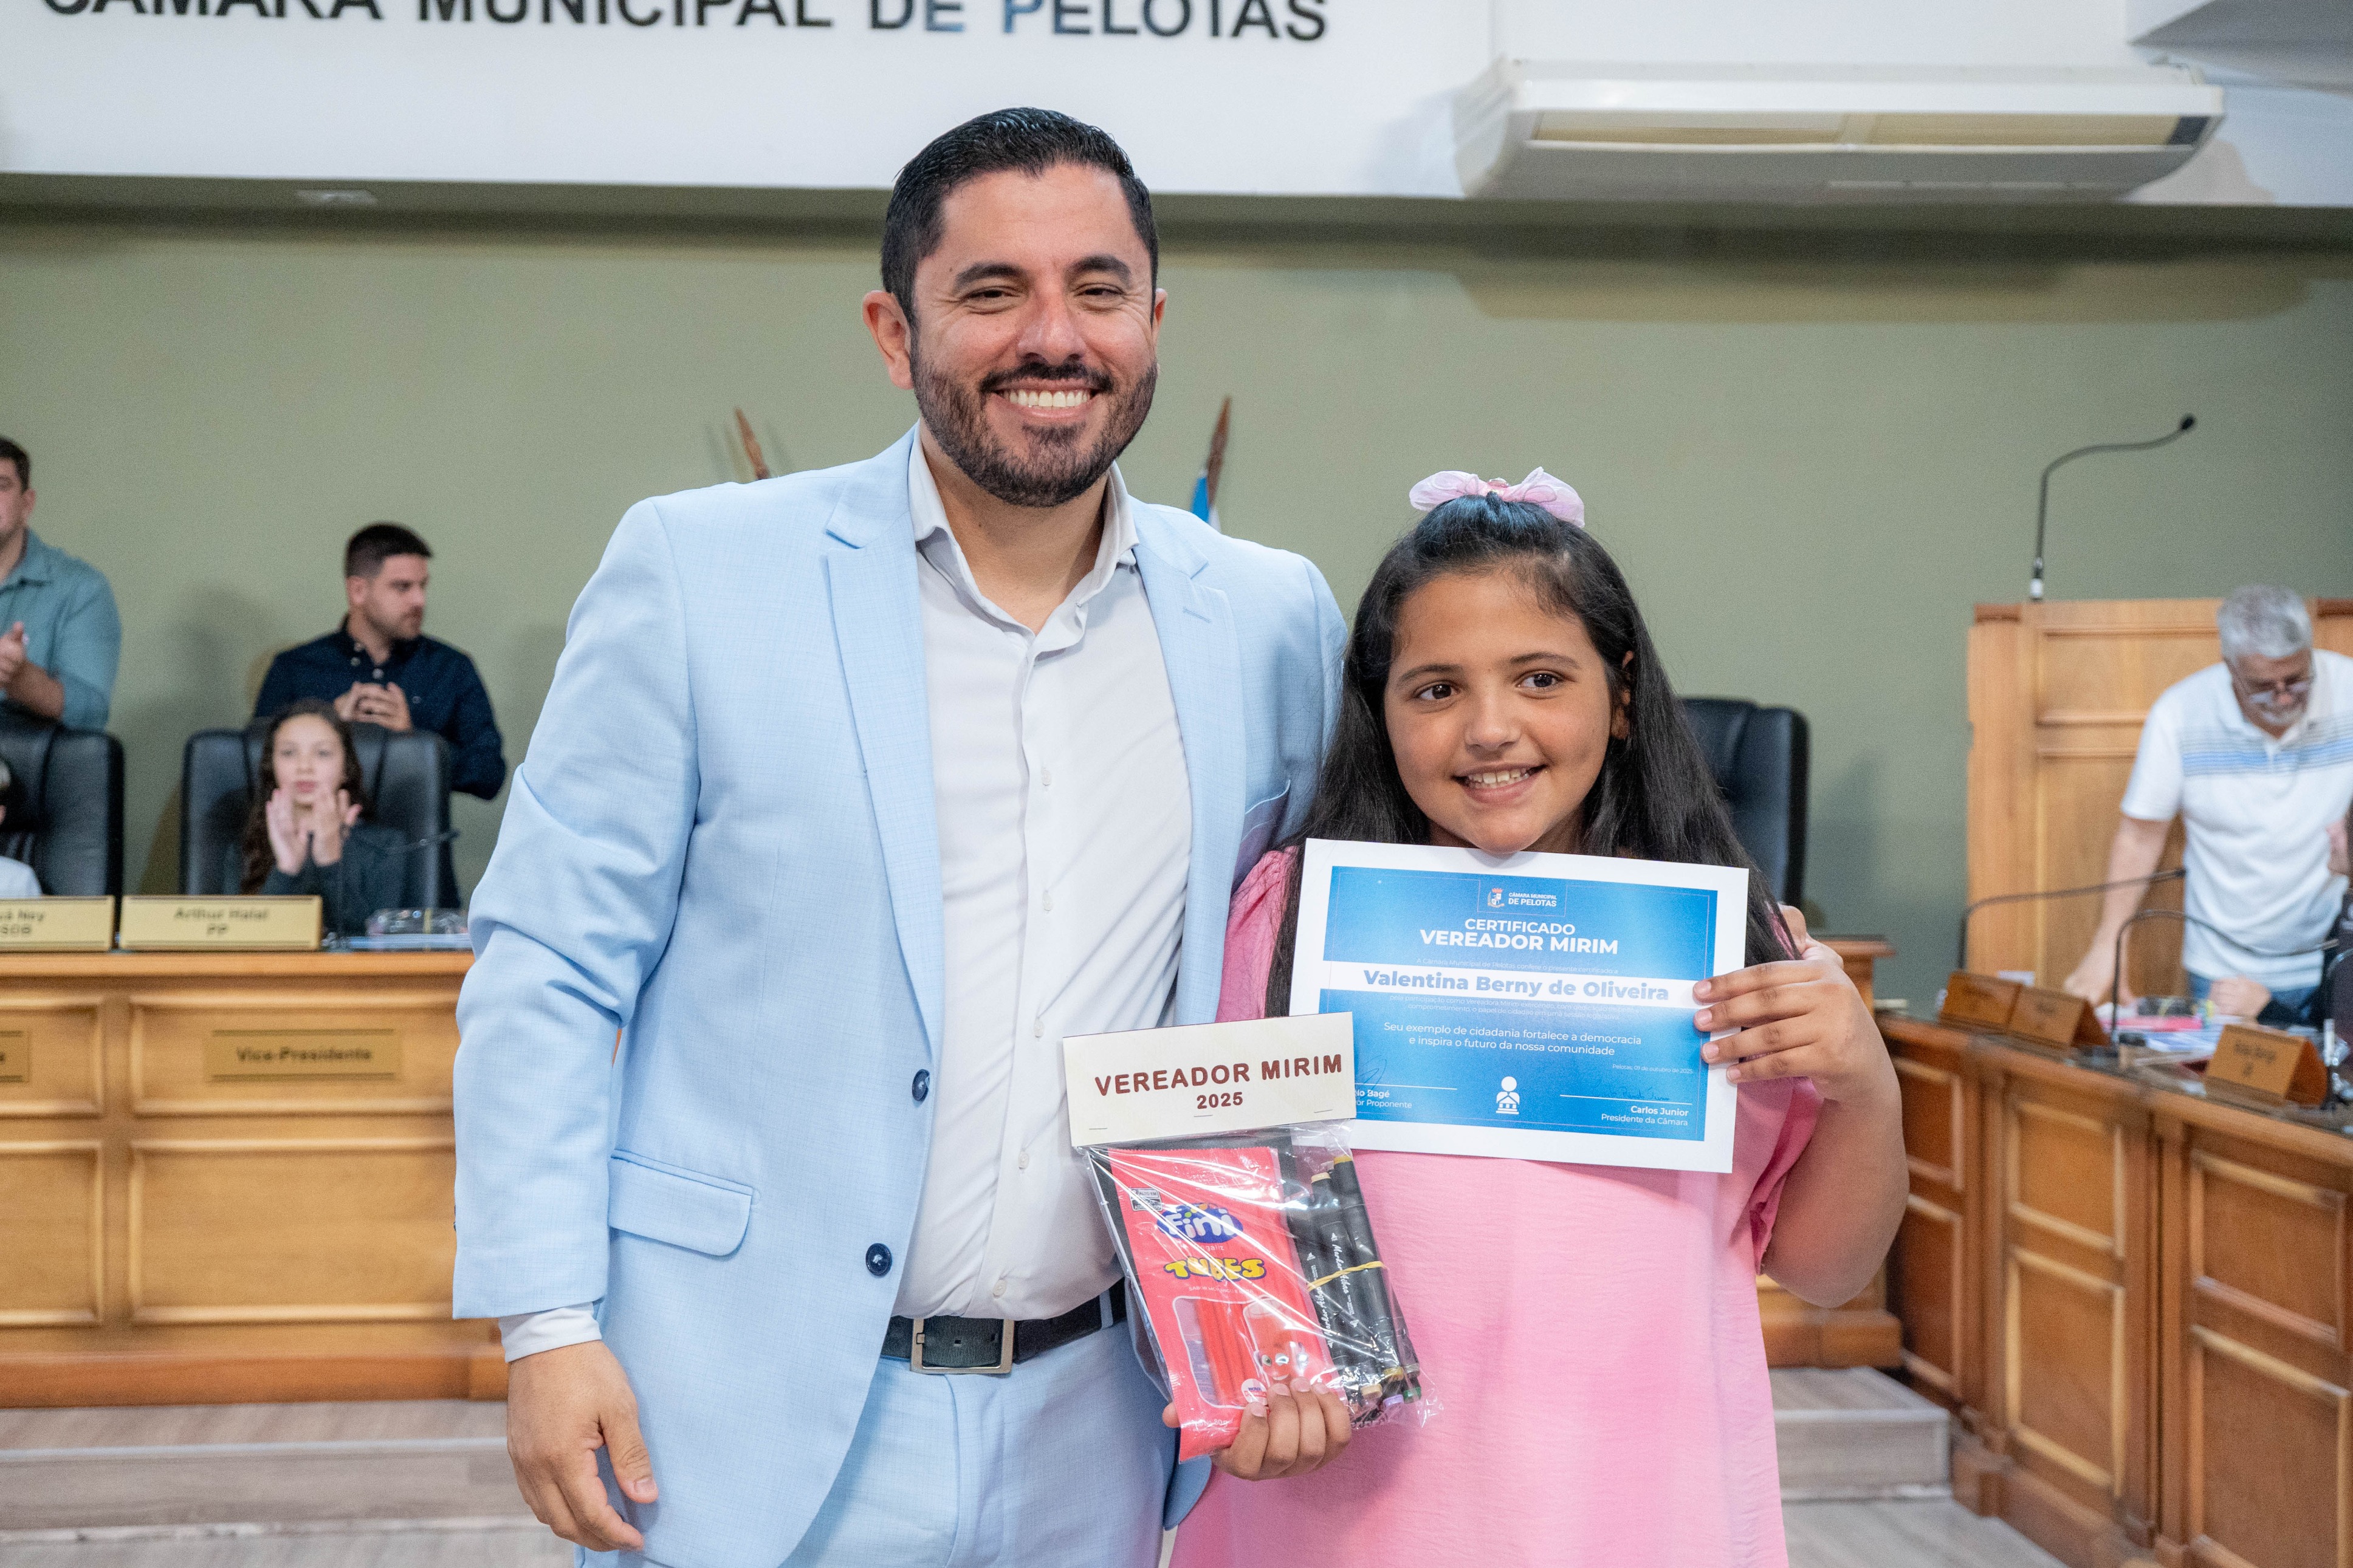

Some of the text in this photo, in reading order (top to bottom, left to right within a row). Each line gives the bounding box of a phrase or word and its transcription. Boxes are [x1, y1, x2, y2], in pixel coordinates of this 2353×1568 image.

[869, 0, 965, 32] DE
[1002, 0, 1327, 41] PELOTAS
[1465, 918, 1576, 936] CERTIFICADO
[1420, 929, 1618, 954] VEREADOR MIRIM
[1450, 959, 1481, 968] Municipal
[1363, 970, 1669, 1001] Valentina Berny de Oliveira
[1384, 1022, 1403, 1031] Seu
[1406, 1025, 1451, 1035] exemplo
[1454, 1025, 1467, 1035] de
[1469, 1027, 1520, 1038] cidadania
[1523, 1029, 1569, 1040] fortalece
[1580, 1032, 1641, 1044] democracia
[1418, 1036, 1452, 1047] inspira
[1465, 1038, 1497, 1049] futuro
[1499, 1040, 1513, 1050] da
[1515, 1042, 1545, 1052] nossa
[1547, 1044, 1615, 1056] comunidade
[1094, 1053, 1342, 1096] VEREADOR MIRIM
[1196, 1091, 1243, 1109] 2025
[1366, 1099, 1412, 1109] Proponente
[1367, 1089, 1390, 1099] Bagé
[1601, 1113, 1644, 1123] Presidente
[1657, 1117, 1688, 1126] Câmara
[1630, 1105, 1689, 1117] Carlos Junior
[1164, 1208, 1236, 1239] Fini
[1163, 1255, 1266, 1281] TUBES
[1331, 1244, 1344, 1272] Marker
